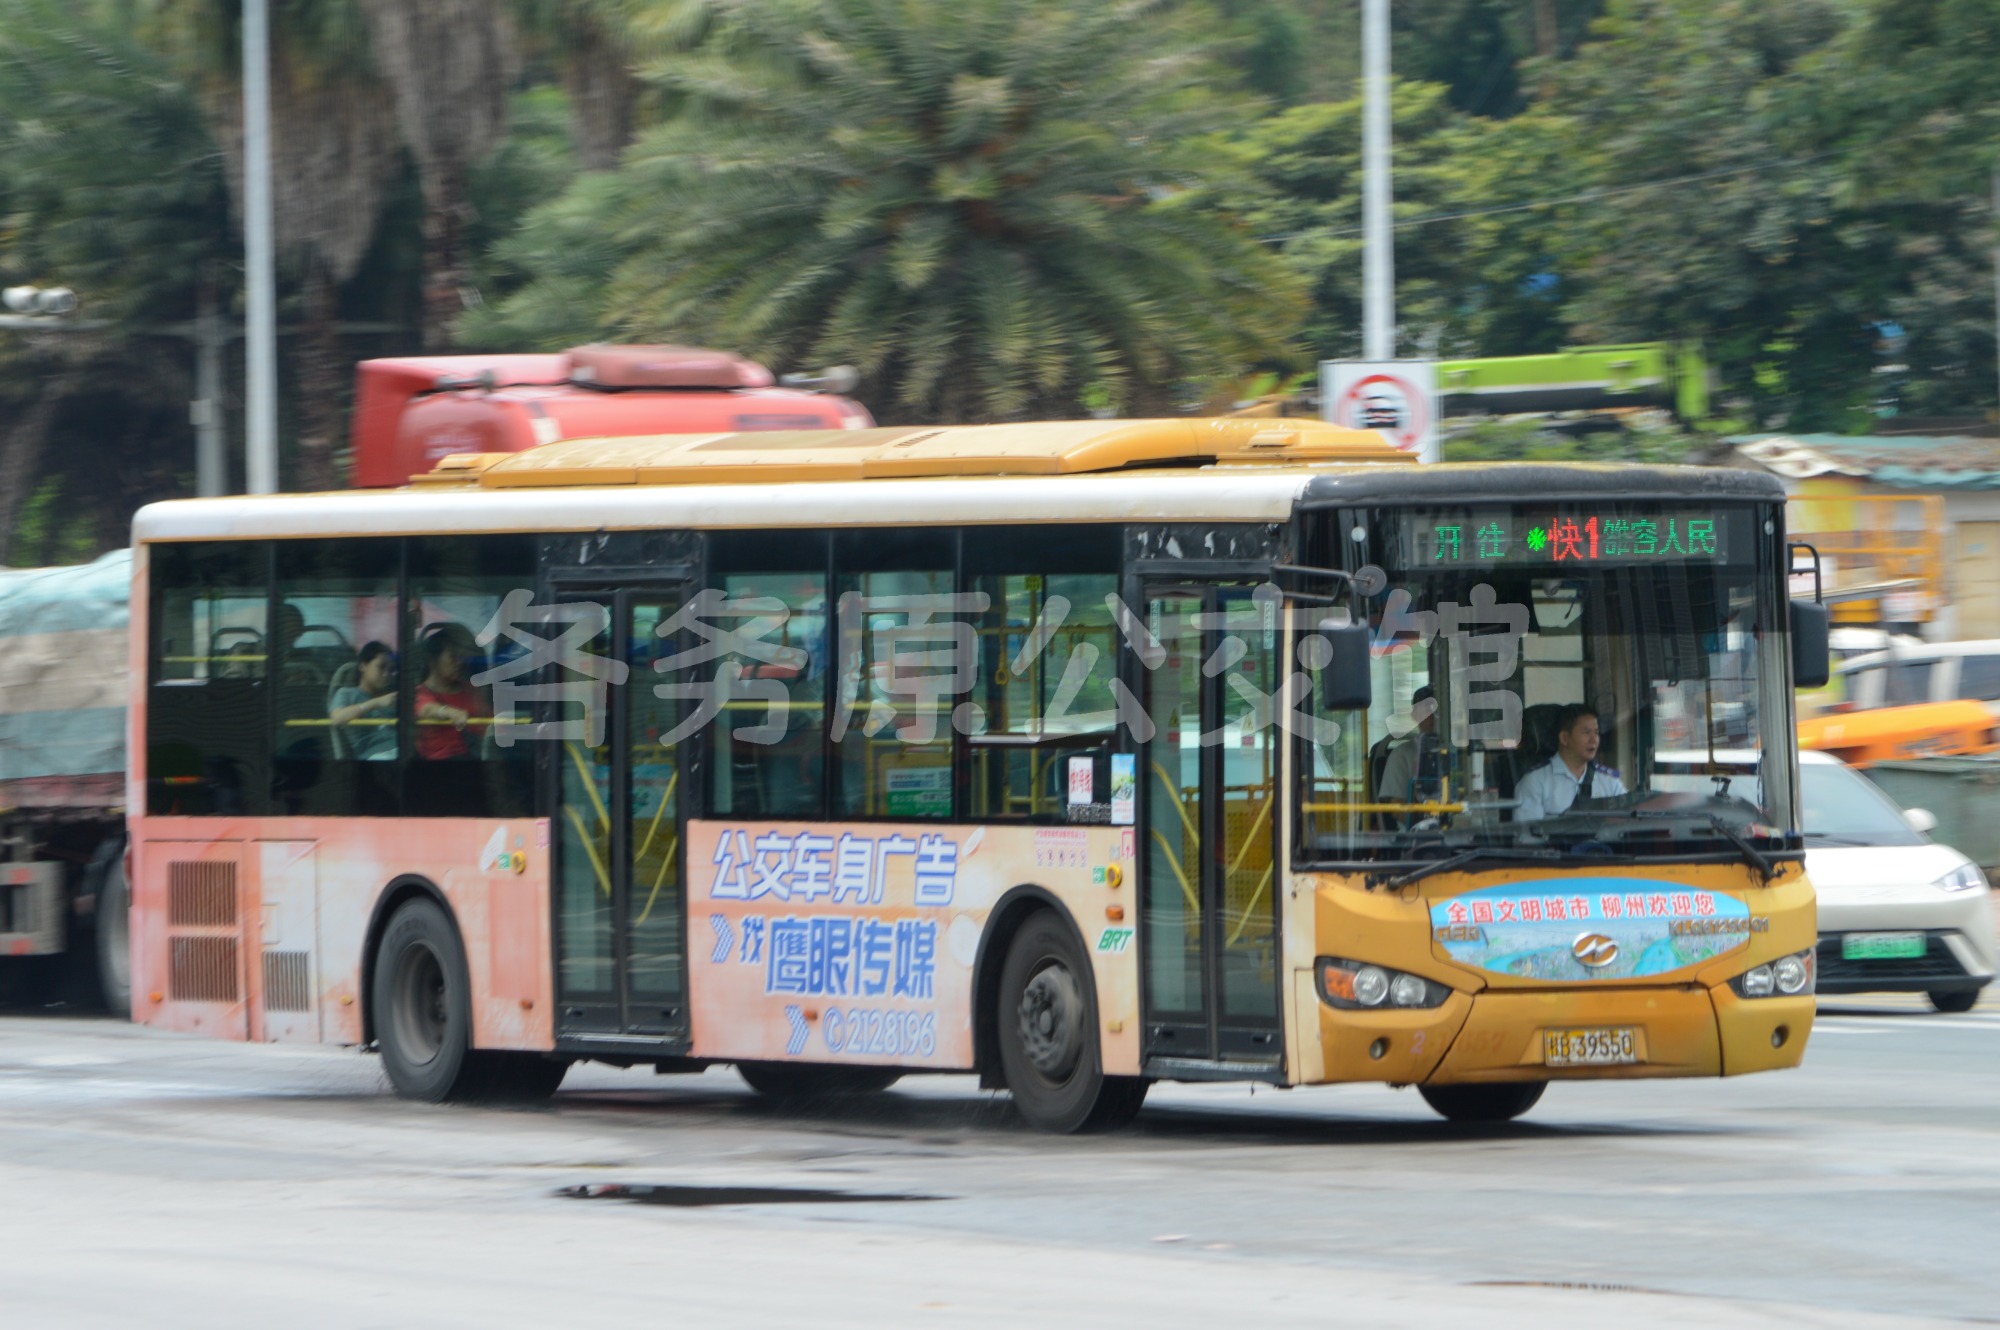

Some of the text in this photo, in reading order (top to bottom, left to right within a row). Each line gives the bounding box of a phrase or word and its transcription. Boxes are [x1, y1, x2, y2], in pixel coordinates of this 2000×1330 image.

[709, 829, 958, 906] 公交车身广告
[1447, 892, 1718, 924] 全国文明城市 柳州欢迎您
[739, 913, 938, 999] 找鹰眼传媒
[1097, 930, 1133, 950] BRT
[847, 1007, 937, 1057] 2128196
